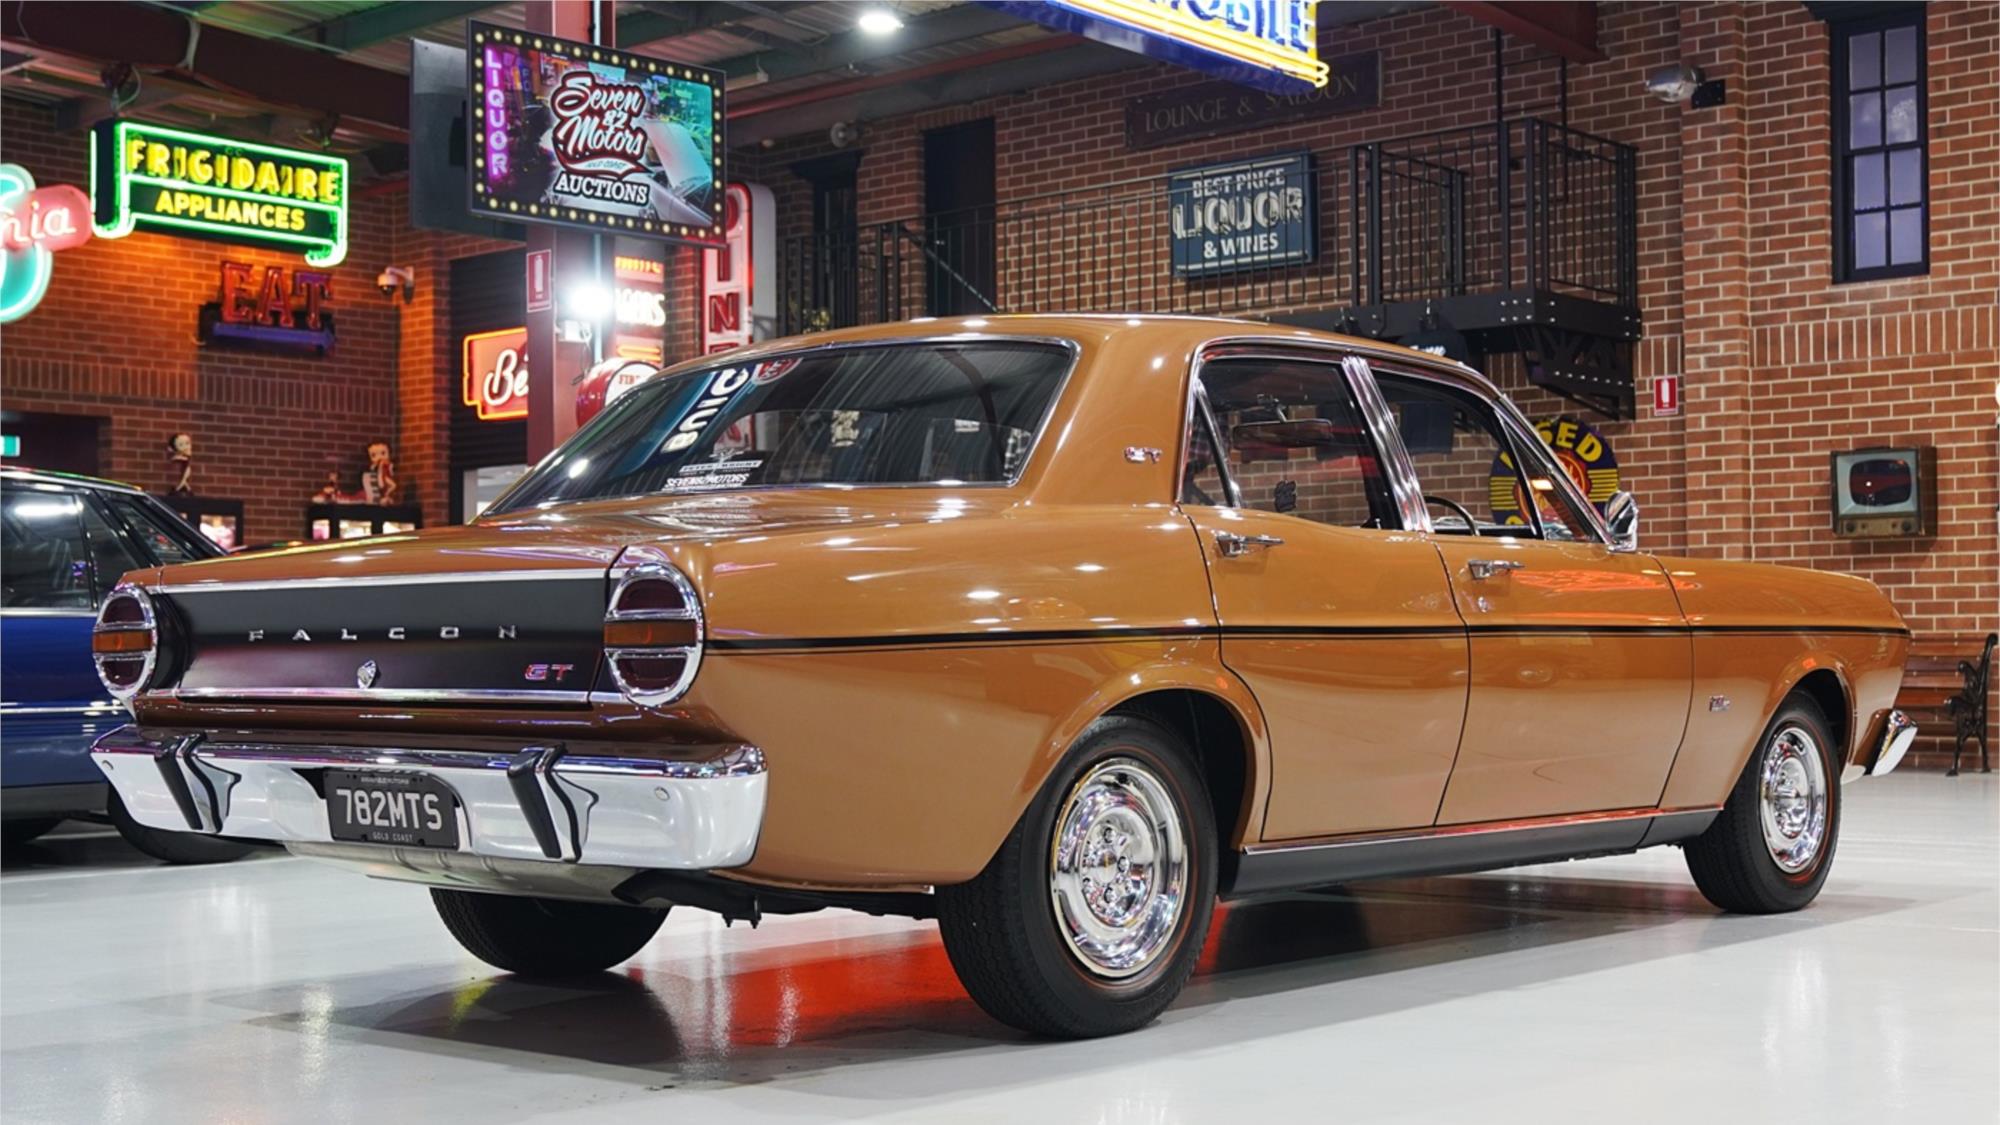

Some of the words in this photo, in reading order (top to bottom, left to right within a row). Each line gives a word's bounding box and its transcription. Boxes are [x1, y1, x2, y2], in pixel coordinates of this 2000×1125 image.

[486, 48, 508, 177] LIQUOR
[556, 77, 641, 117] Seven
[1145, 98, 1229, 133] LOUNGE
[1237, 95, 1255, 116] &
[557, 115, 644, 156] Motors
[603, 109, 628, 128] 82
[126, 137, 341, 204] FRIGIDAIRE
[555, 173, 649, 204] AUCTIONS
[1192, 176, 1232, 198] BEST
[1236, 168, 1286, 191] PRICE
[155, 190, 305, 230] APPLIANCES
[1172, 187, 1304, 239] LIQUOR
[1203, 241, 1217, 259] &
[1220, 233, 1279, 255] WINES
[221, 261, 333, 331] EAT
[483, 348, 529, 406] Be
[248, 625, 517, 641] FALCON
[524, 663, 575, 681] GT
[336, 788, 443, 831] 782MTS
[372, 831, 390, 841] GOLD
[393, 832, 413, 842] COAST
